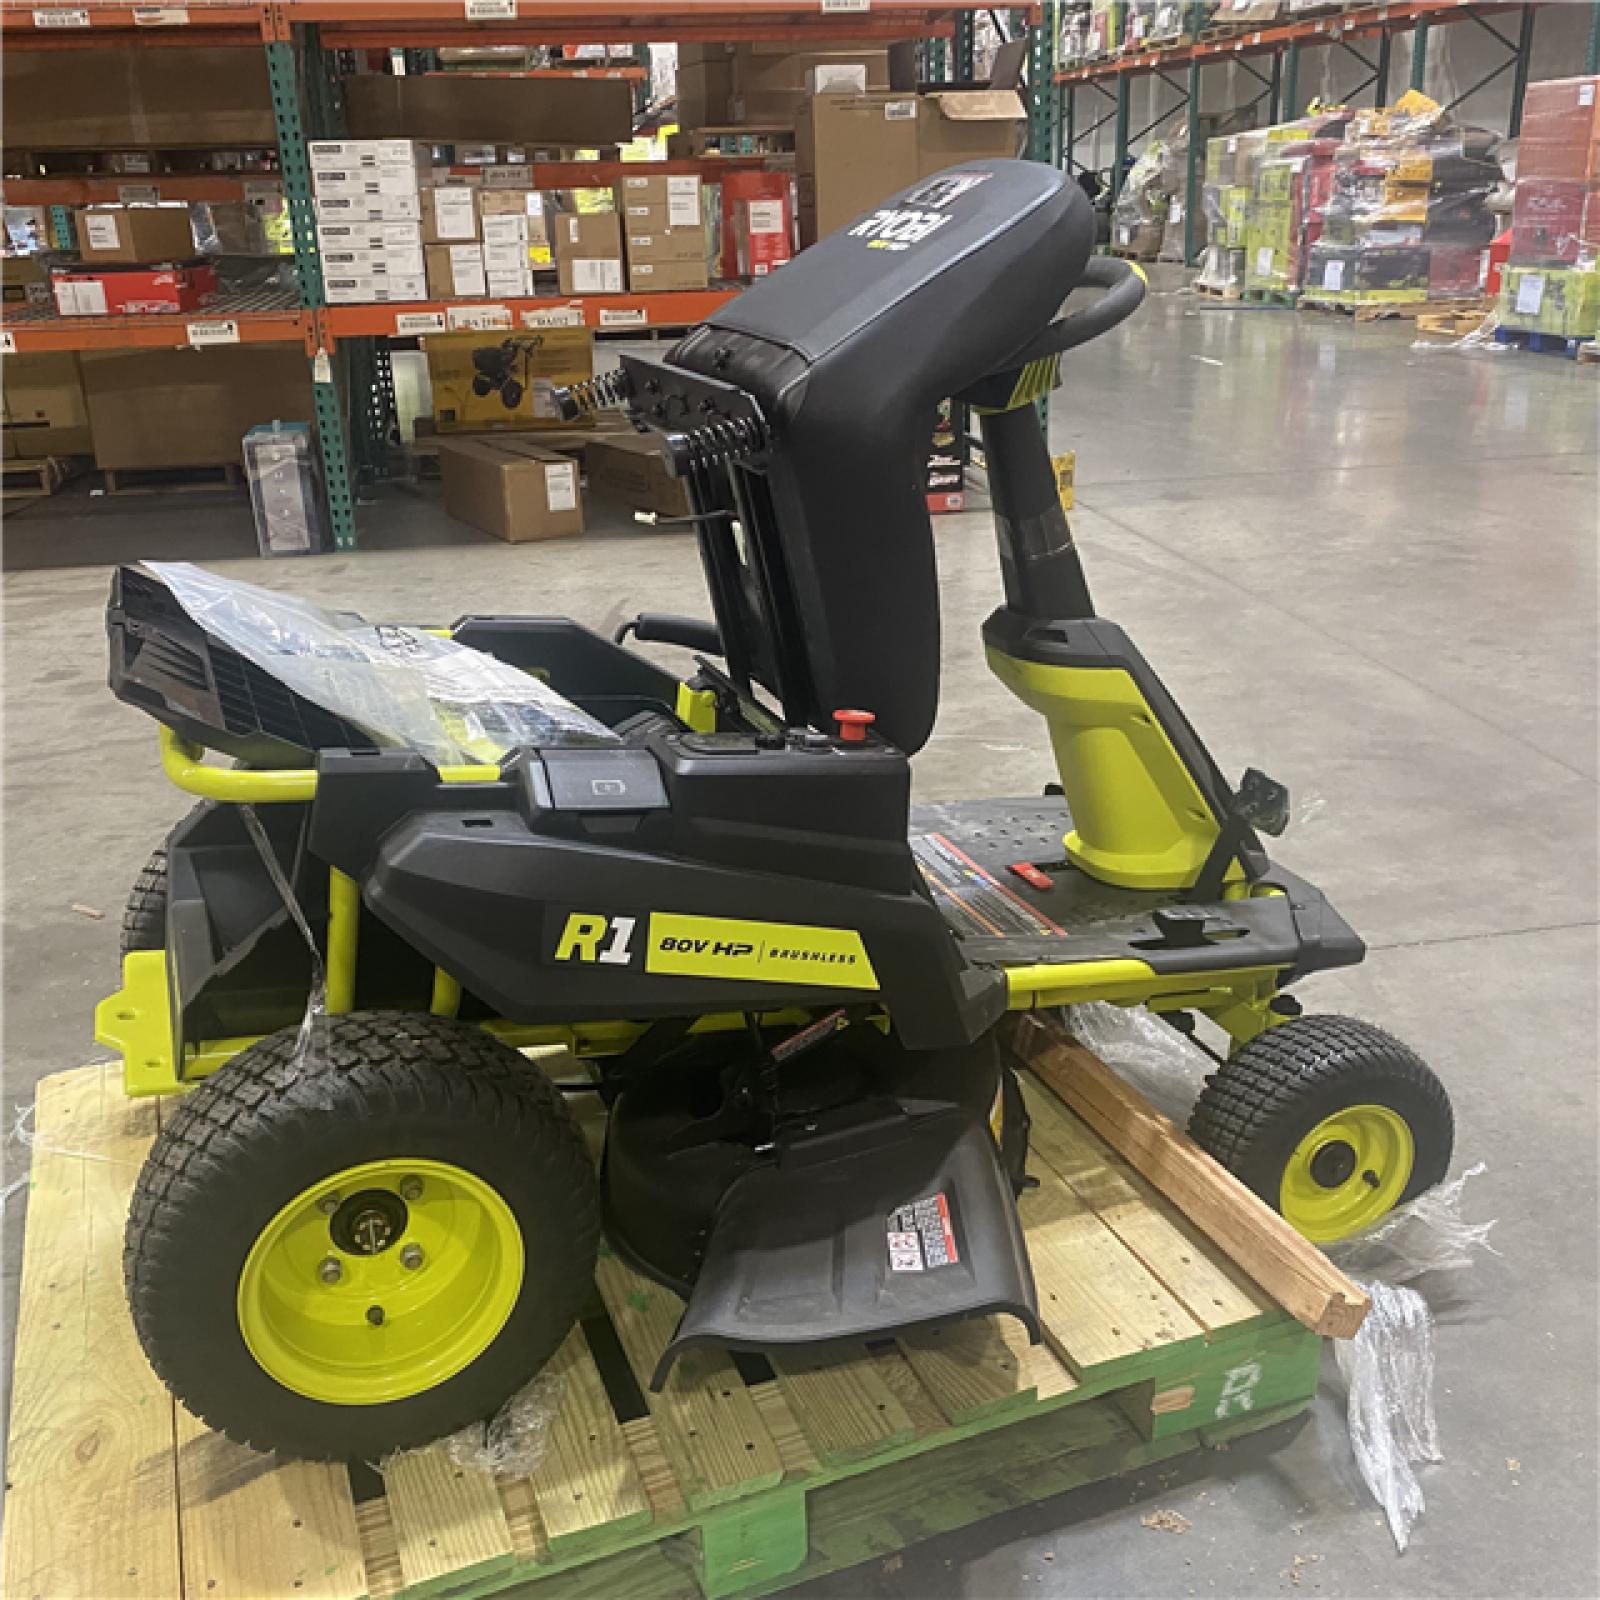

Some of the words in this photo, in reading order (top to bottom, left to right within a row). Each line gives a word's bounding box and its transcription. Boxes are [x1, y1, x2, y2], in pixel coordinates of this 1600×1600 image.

[847, 209, 953, 243] RYOBI
[555, 912, 636, 964] R1
[659, 937, 711, 953] 80V
[712, 941, 754, 956] HP
[769, 947, 856, 965] BRUSHLESS
[1215, 1364, 1262, 1418] R
